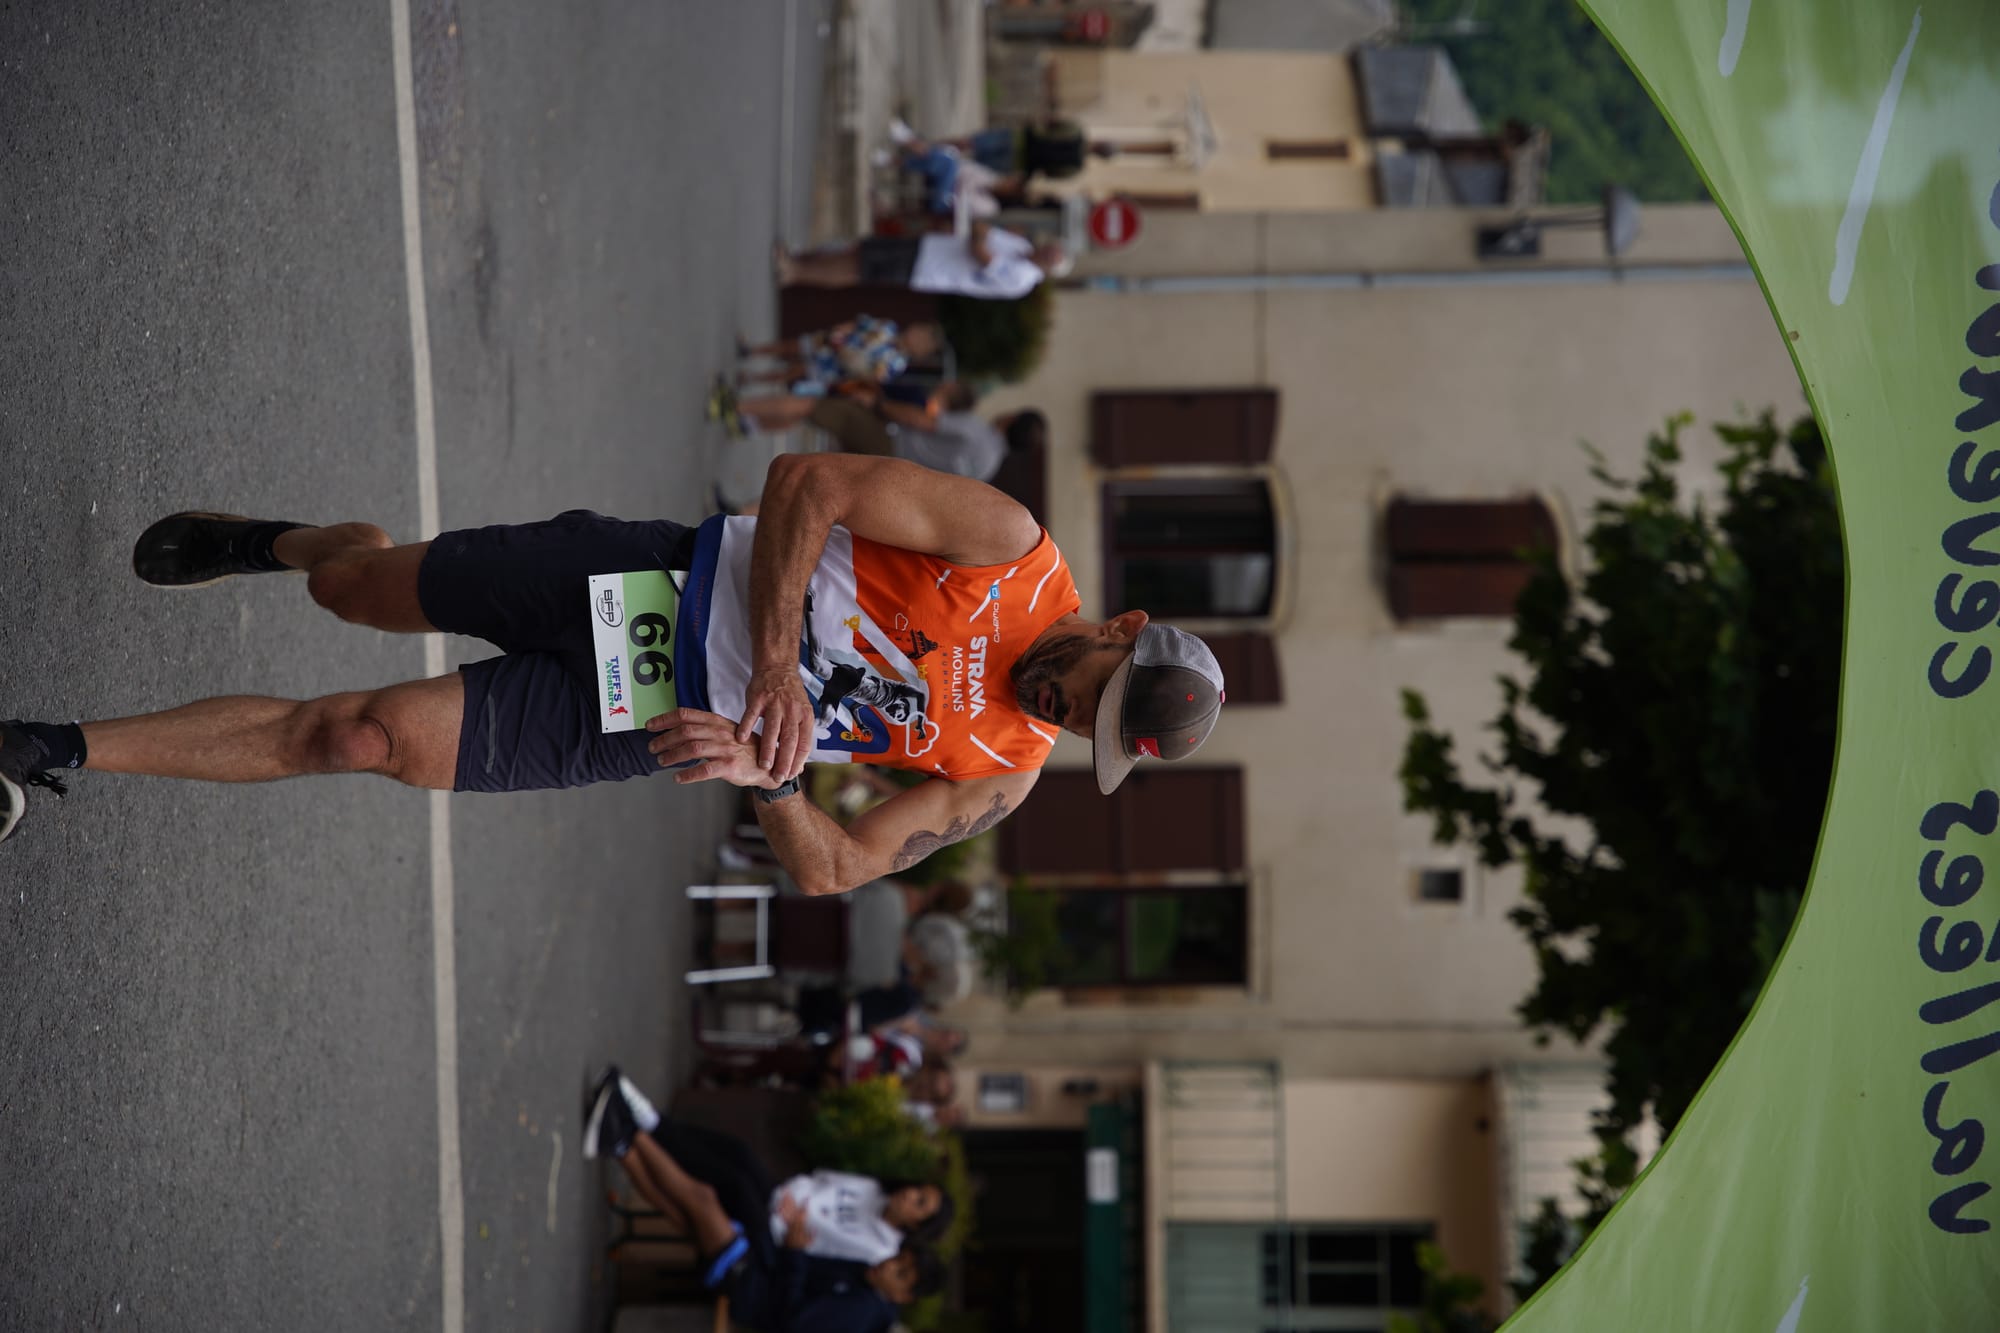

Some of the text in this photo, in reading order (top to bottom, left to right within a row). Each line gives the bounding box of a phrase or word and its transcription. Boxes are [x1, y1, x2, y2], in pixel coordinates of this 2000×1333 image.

[603, 589, 615, 623] BFP
[629, 612, 674, 686] 66
[604, 660, 615, 706] Aventure
[610, 655, 622, 702] TUFF'S
[951, 646, 965, 712] MOULINS
[968, 635, 988, 720] STRAVA
